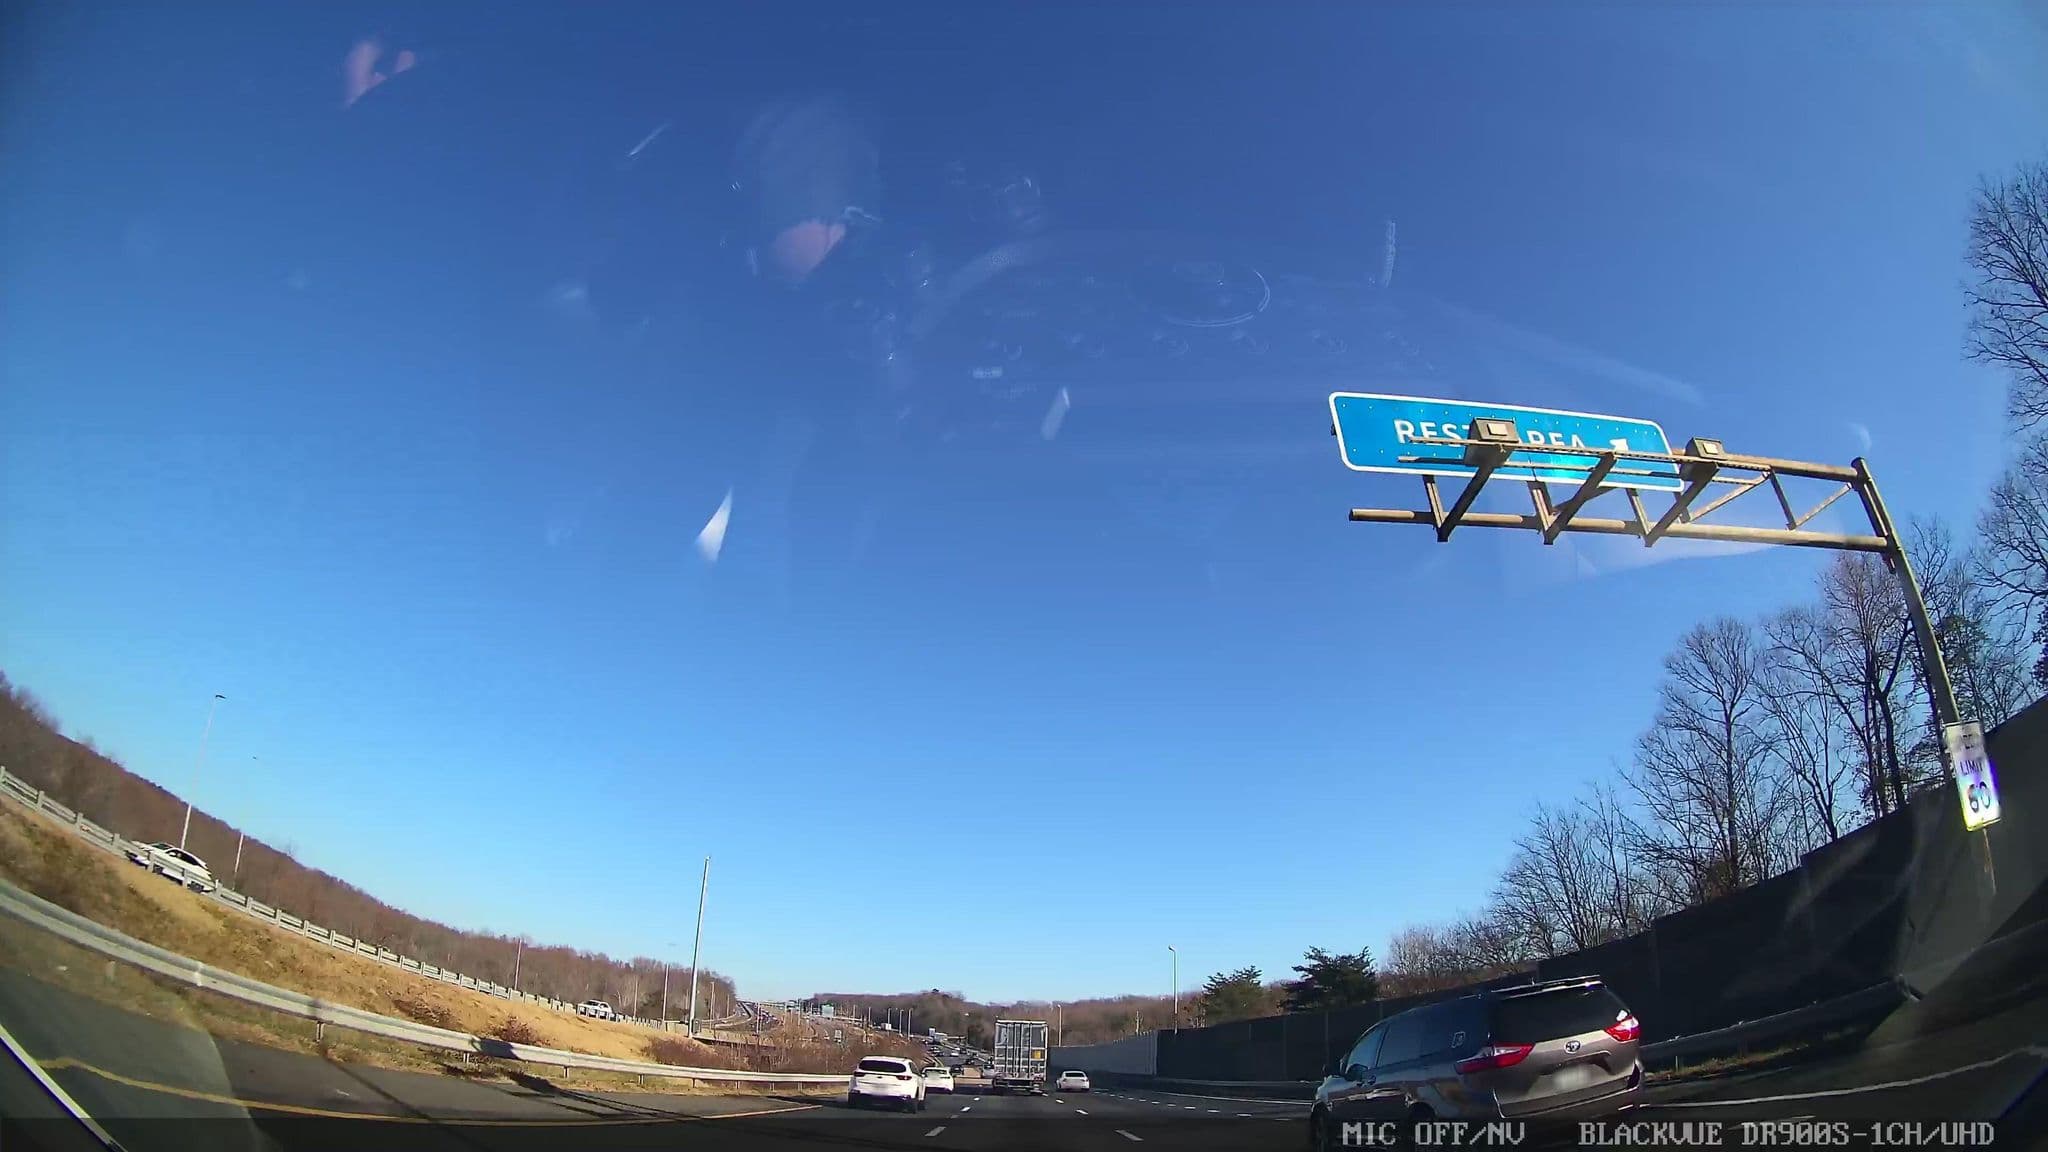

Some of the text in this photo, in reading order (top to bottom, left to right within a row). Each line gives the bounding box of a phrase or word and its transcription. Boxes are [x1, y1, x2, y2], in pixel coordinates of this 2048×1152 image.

[1516, 430, 1593, 456] REA
[1960, 759, 1984, 776] LIMIT
[1967, 781, 1991, 813] 60
